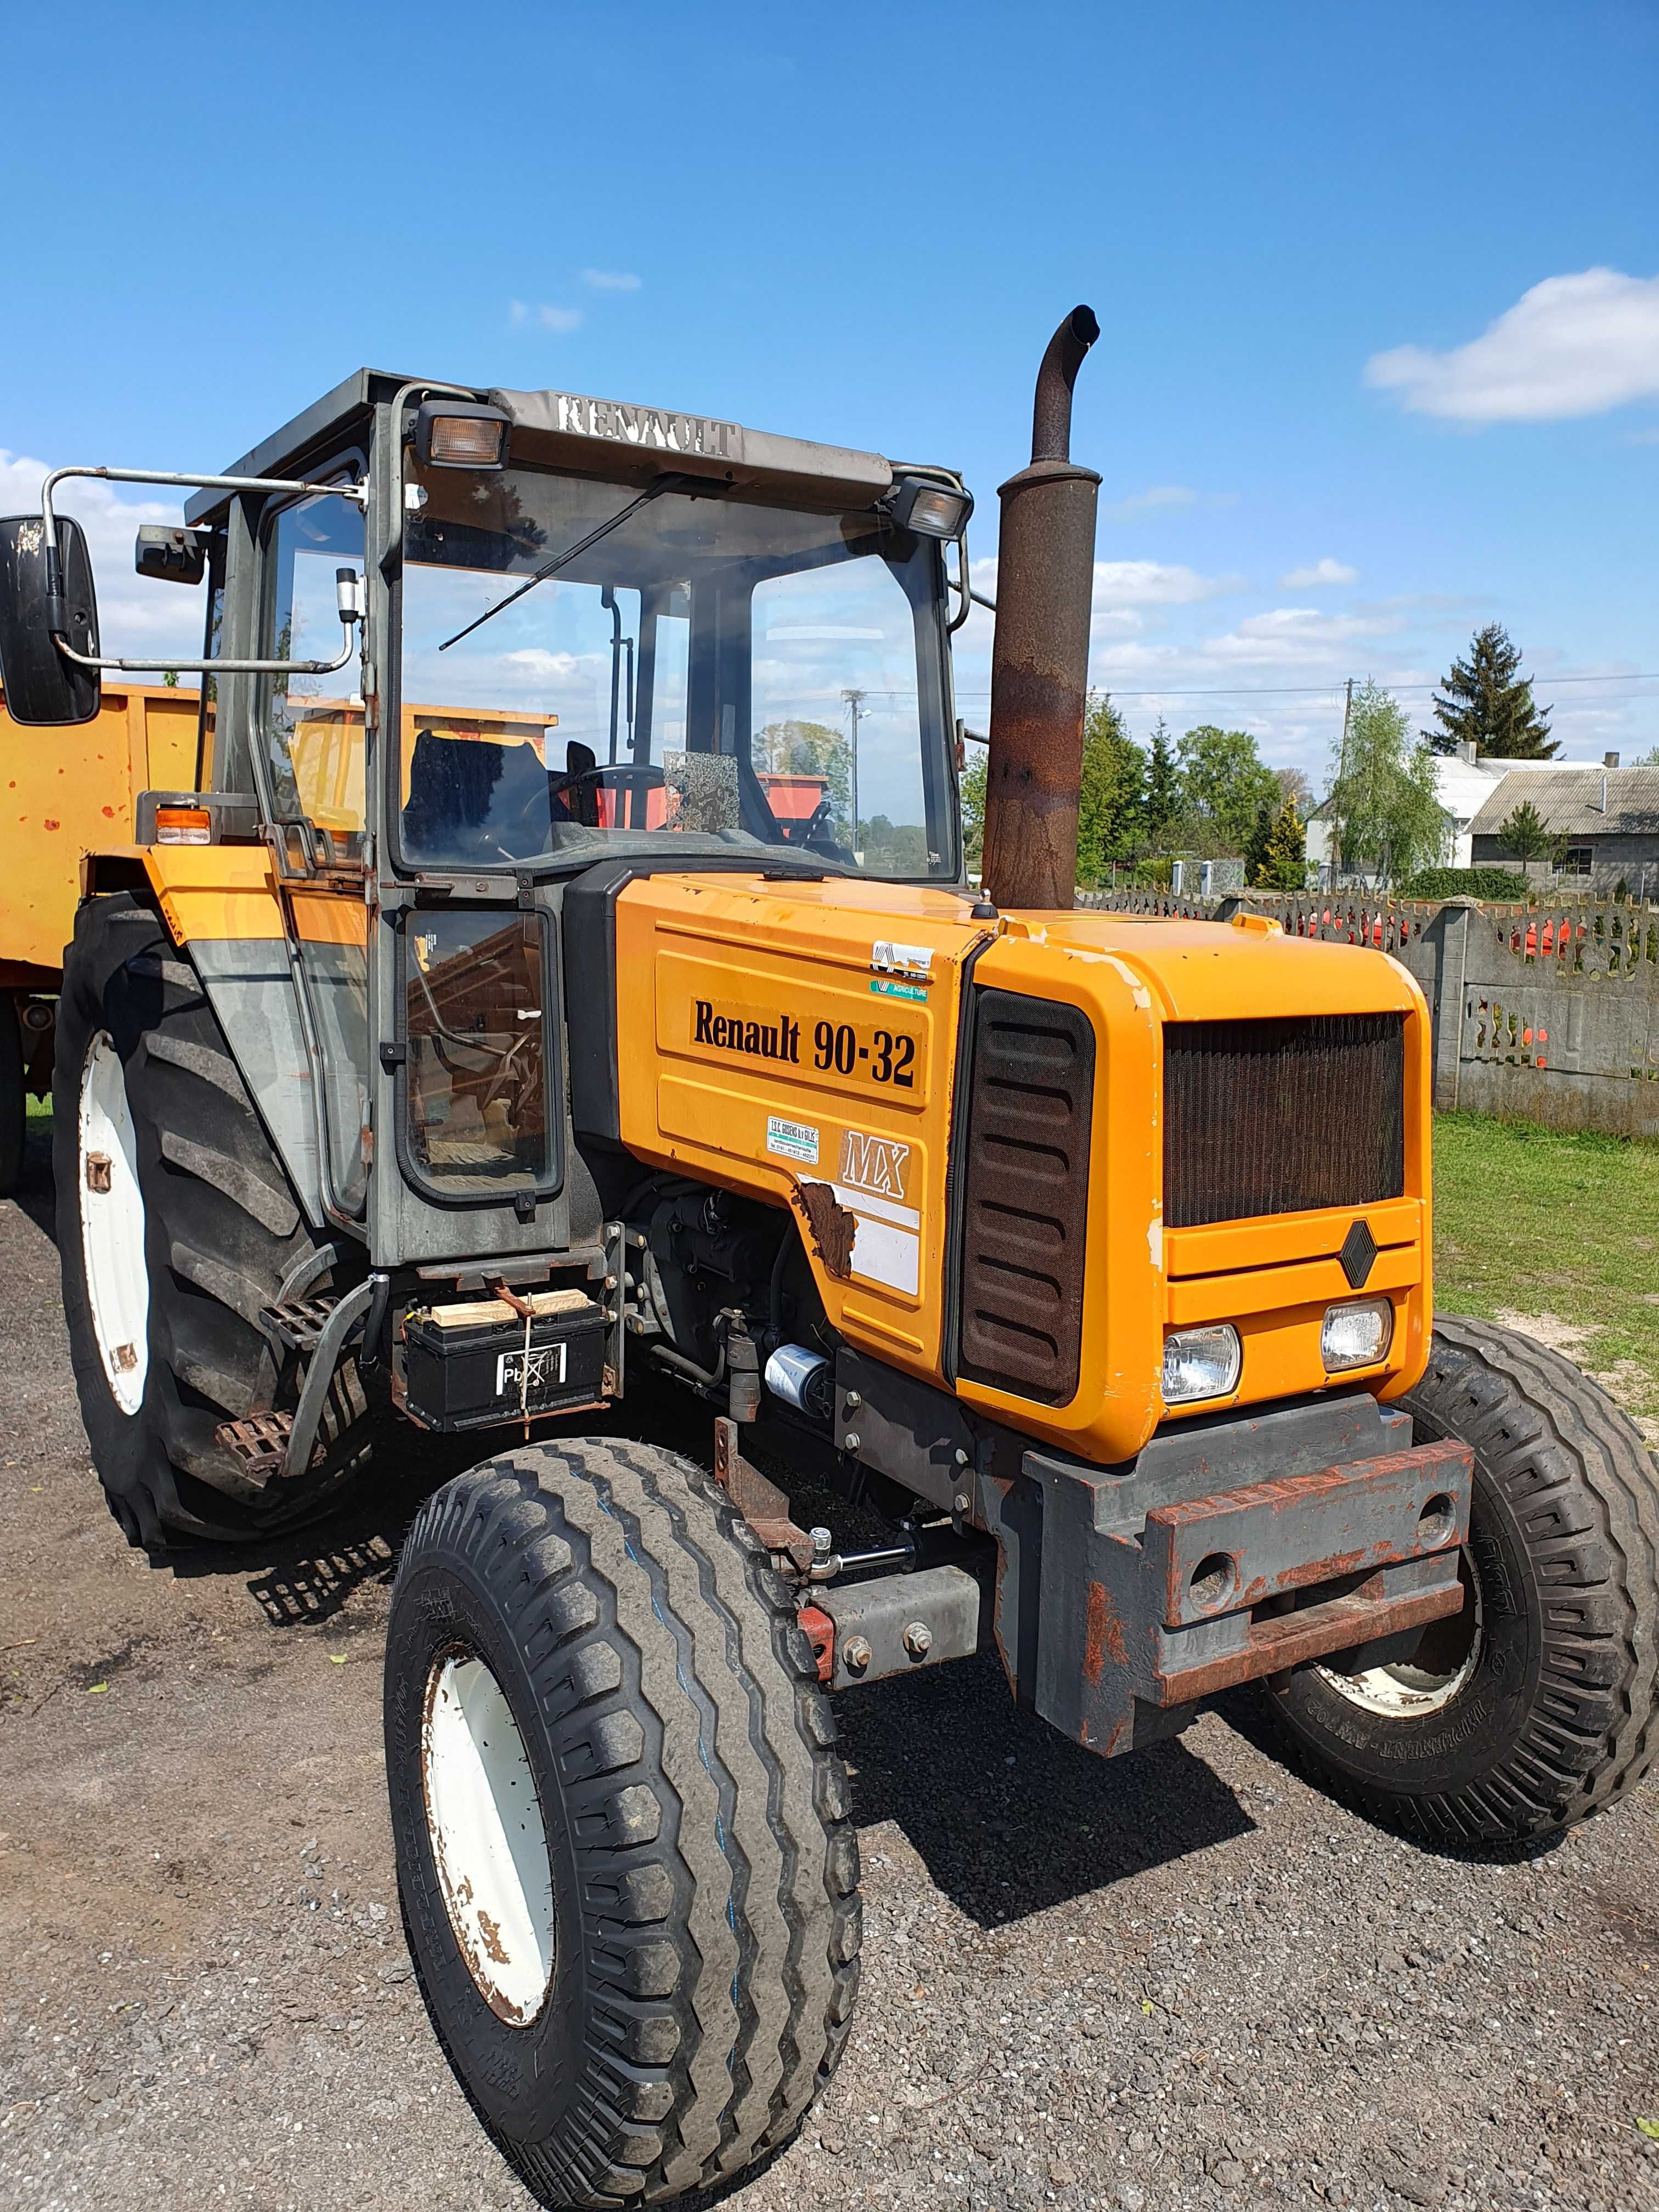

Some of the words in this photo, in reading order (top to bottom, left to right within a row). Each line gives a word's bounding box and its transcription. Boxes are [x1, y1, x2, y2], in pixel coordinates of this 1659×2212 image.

[556, 394, 736, 458] RENAULT
[893, 984, 927, 997] AGRICULTURE
[694, 1000, 800, 1064] Renault
[814, 1021, 915, 1088] 90-32
[782, 1123, 797, 1137] GOSENS
[843, 1131, 909, 1199] MX
[504, 1368, 522, 1384] Pb
[1379, 1699, 1488, 1760] IMPLEMENT
